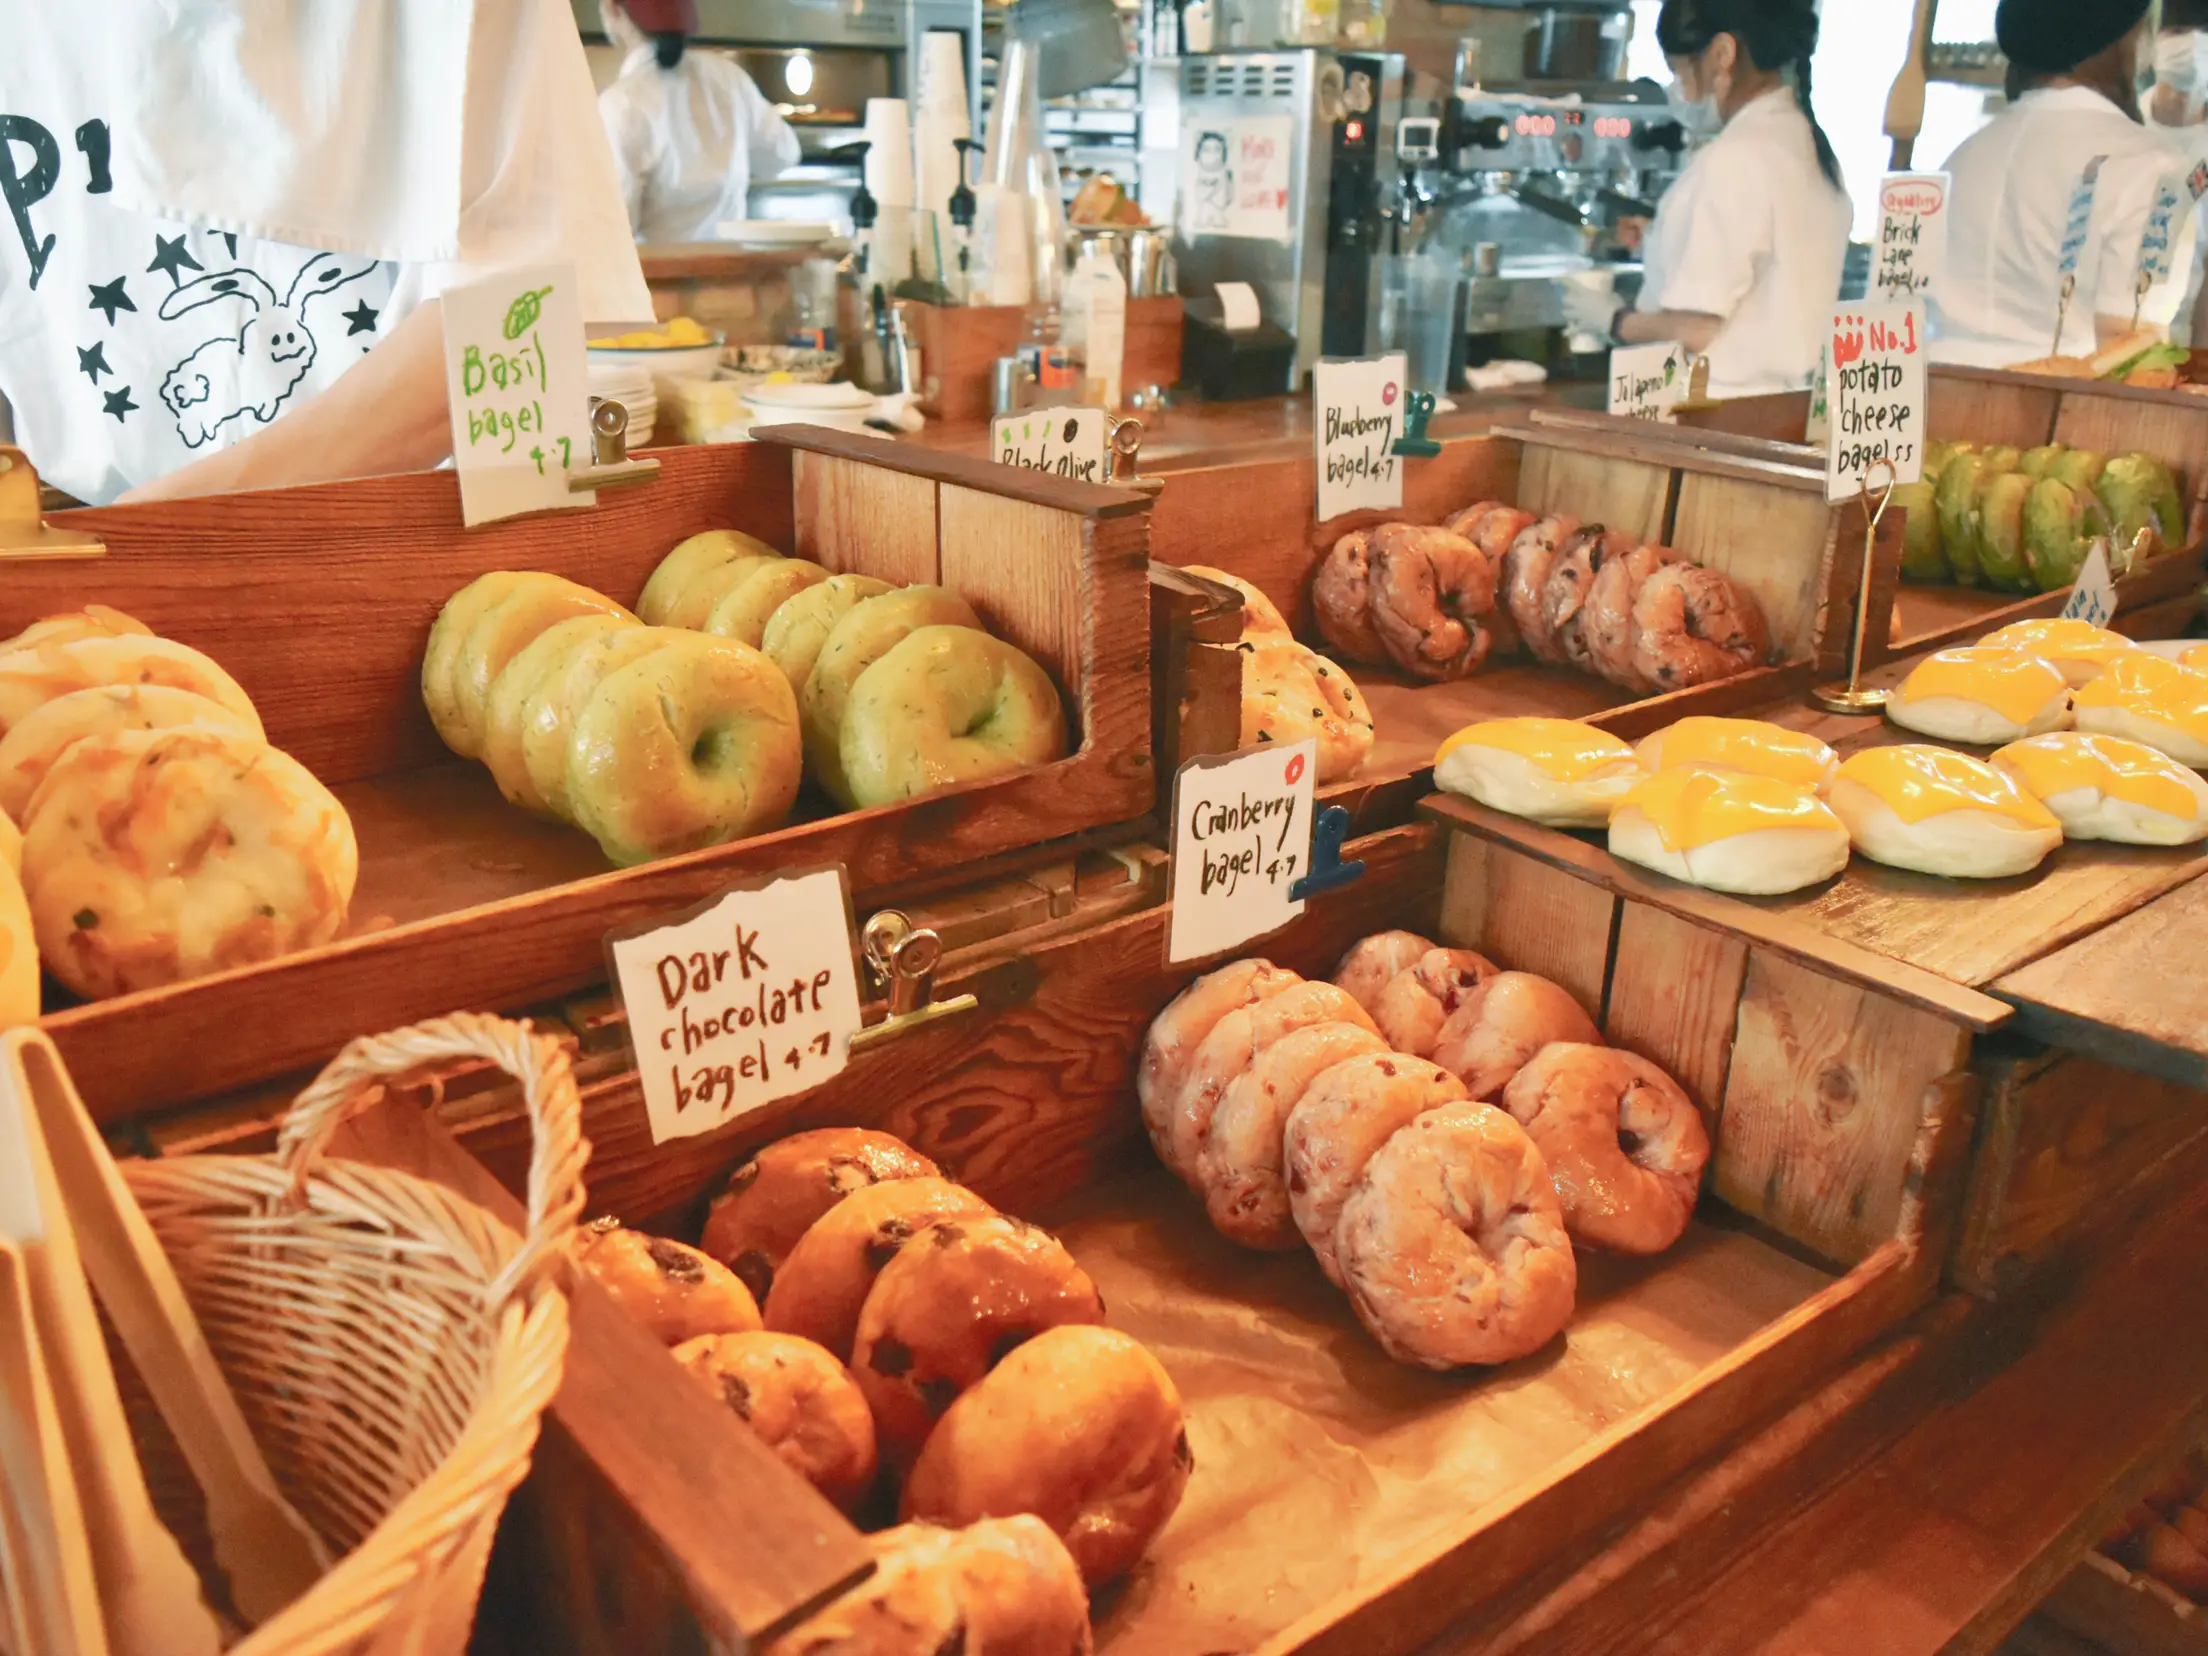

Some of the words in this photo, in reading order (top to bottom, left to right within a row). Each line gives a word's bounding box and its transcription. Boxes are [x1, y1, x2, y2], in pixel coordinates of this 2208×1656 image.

[1883, 214, 1921, 244] Brick
[1870, 311, 1917, 354] No.1
[462, 330, 547, 397] Basil
[1839, 357, 1903, 413] potato
[468, 400, 543, 454] bagel
[1841, 397, 1911, 435] cheese
[1327, 445, 1369, 489] bagel
[1837, 439, 1889, 481] bagel
[1191, 792, 1296, 852] Cranberry
[1200, 835, 1261, 897] bagel
[1265, 854, 1297, 884] 4.7
[656, 923, 769, 1011] Dark
[660, 969, 831, 1056] chocolate
[671, 1039, 770, 1114] bagel
